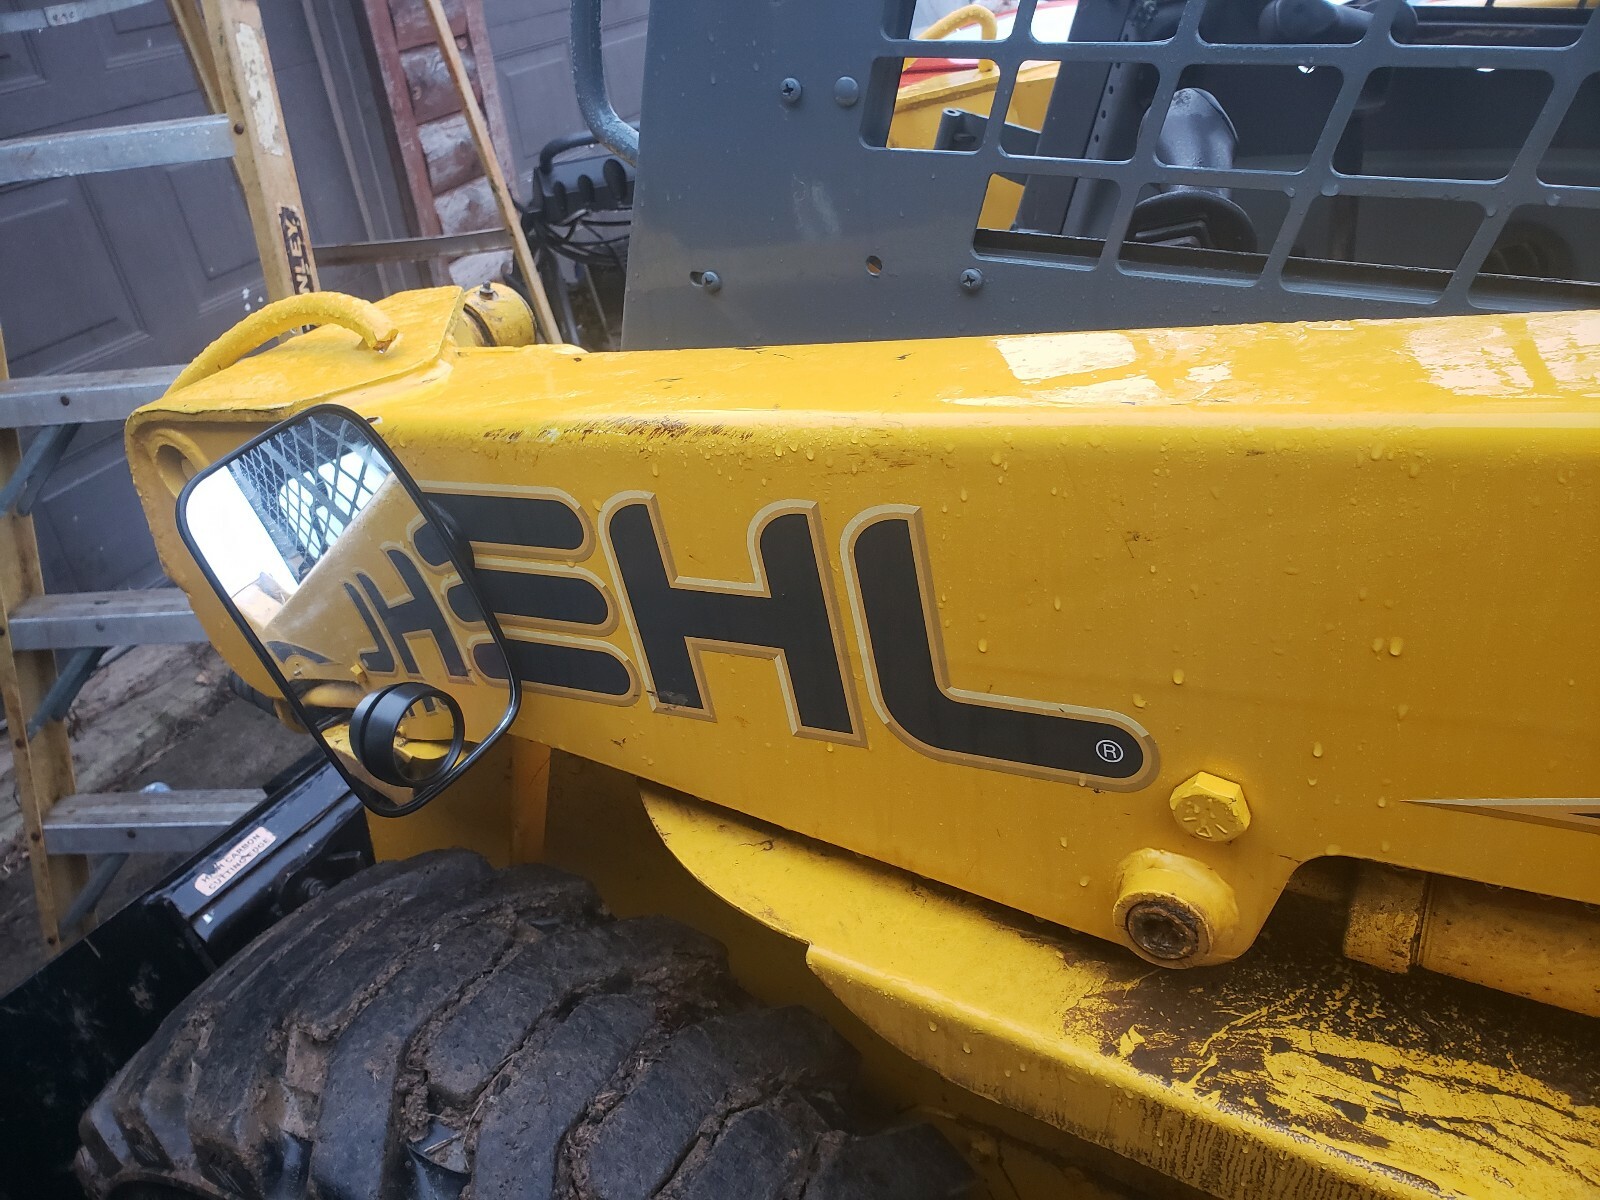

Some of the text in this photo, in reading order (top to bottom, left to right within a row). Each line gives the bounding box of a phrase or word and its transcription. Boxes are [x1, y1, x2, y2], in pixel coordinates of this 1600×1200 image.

[284, 219, 310, 294] NLEY
[419, 483, 1161, 793] EHL
[225, 833, 260, 863] CARBON
